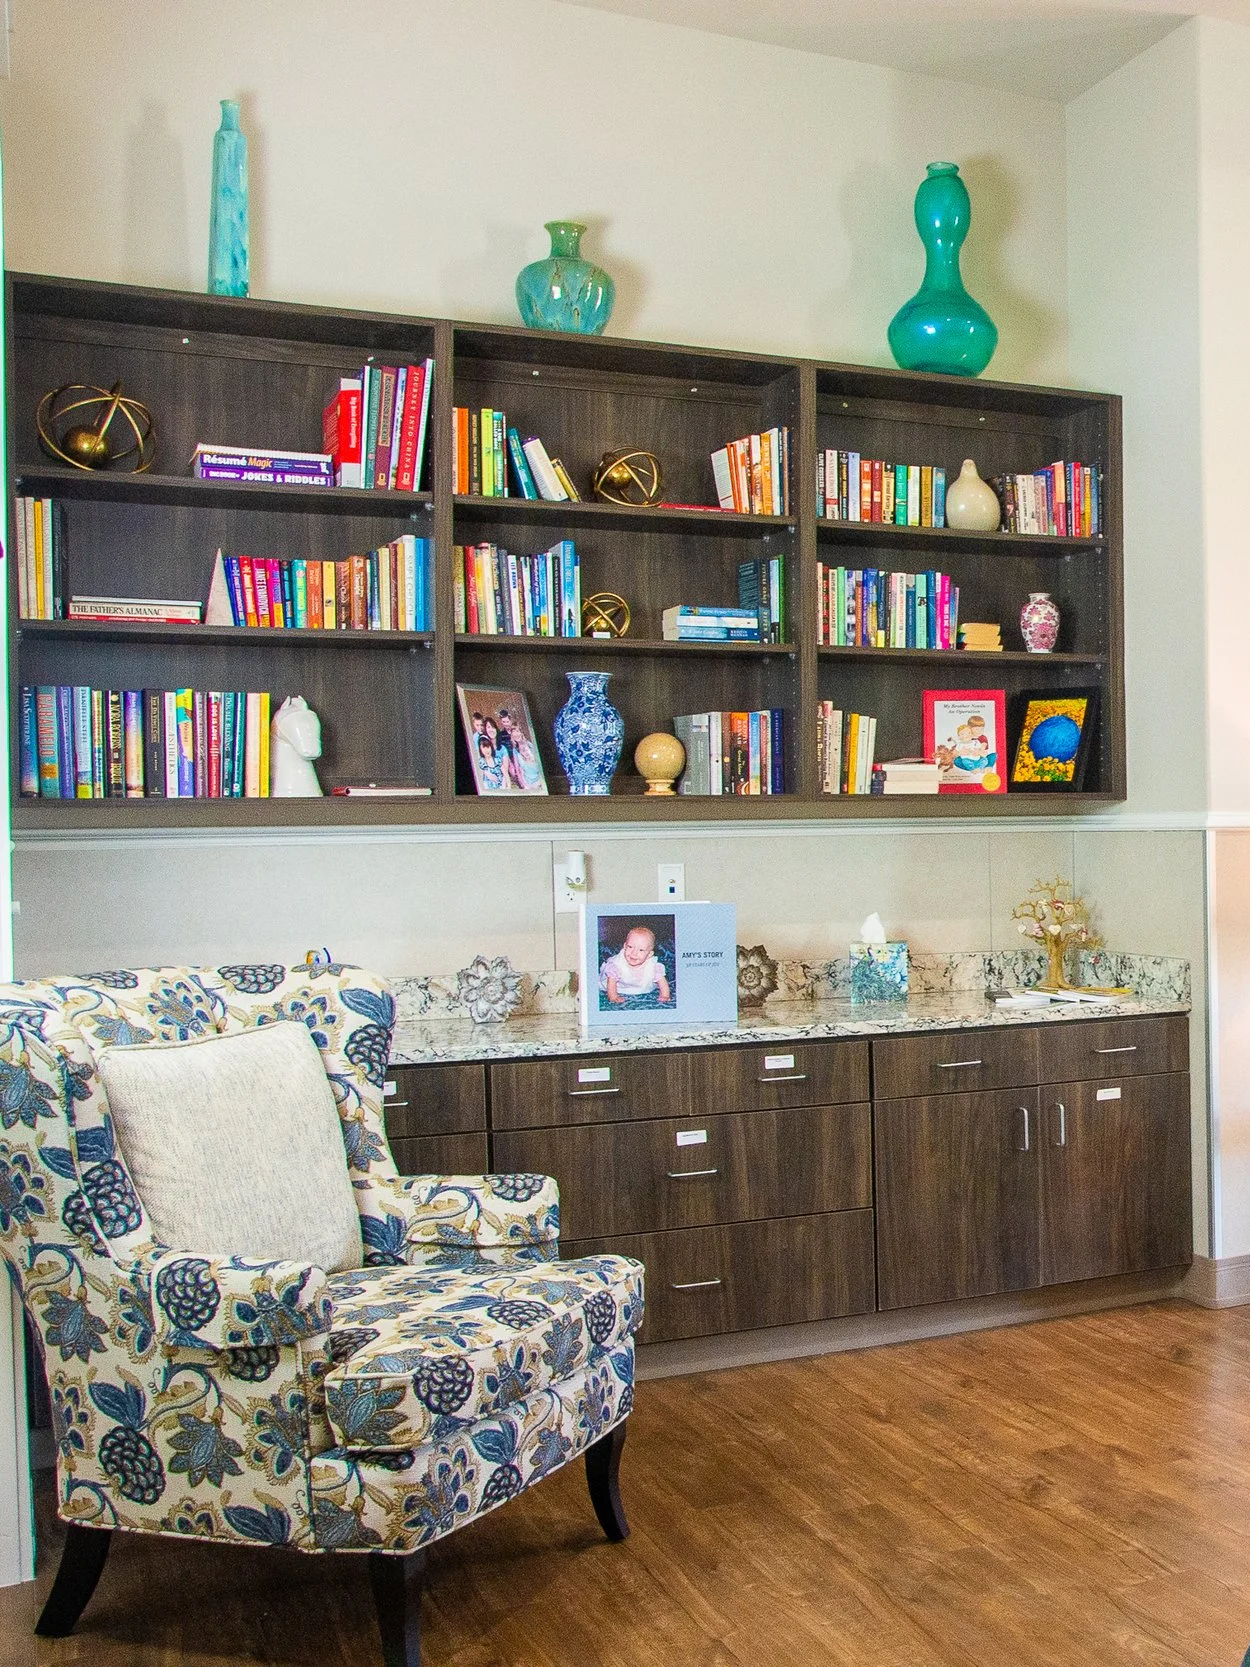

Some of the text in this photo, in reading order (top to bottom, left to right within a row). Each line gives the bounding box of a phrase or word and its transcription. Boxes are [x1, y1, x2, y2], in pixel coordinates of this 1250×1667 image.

[404, 371, 420, 469] JOURNEY INTO CHINA
[349, 423, 357, 448] Everything
[203, 453, 247, 467] Résumé
[247, 457, 272, 469] Magic
[241, 472, 274, 482] JOKES
[276, 475, 283, 483] &
[284, 474, 327, 485] RIDDLES
[255, 568, 269, 615] JANET EVANOVICH
[72, 604, 162, 616] THE FATHER'S ALMANAC
[111, 704, 121, 721] NORA
[38, 694, 55, 757] CARAMELO
[111, 724, 121, 749] ROBERTS
